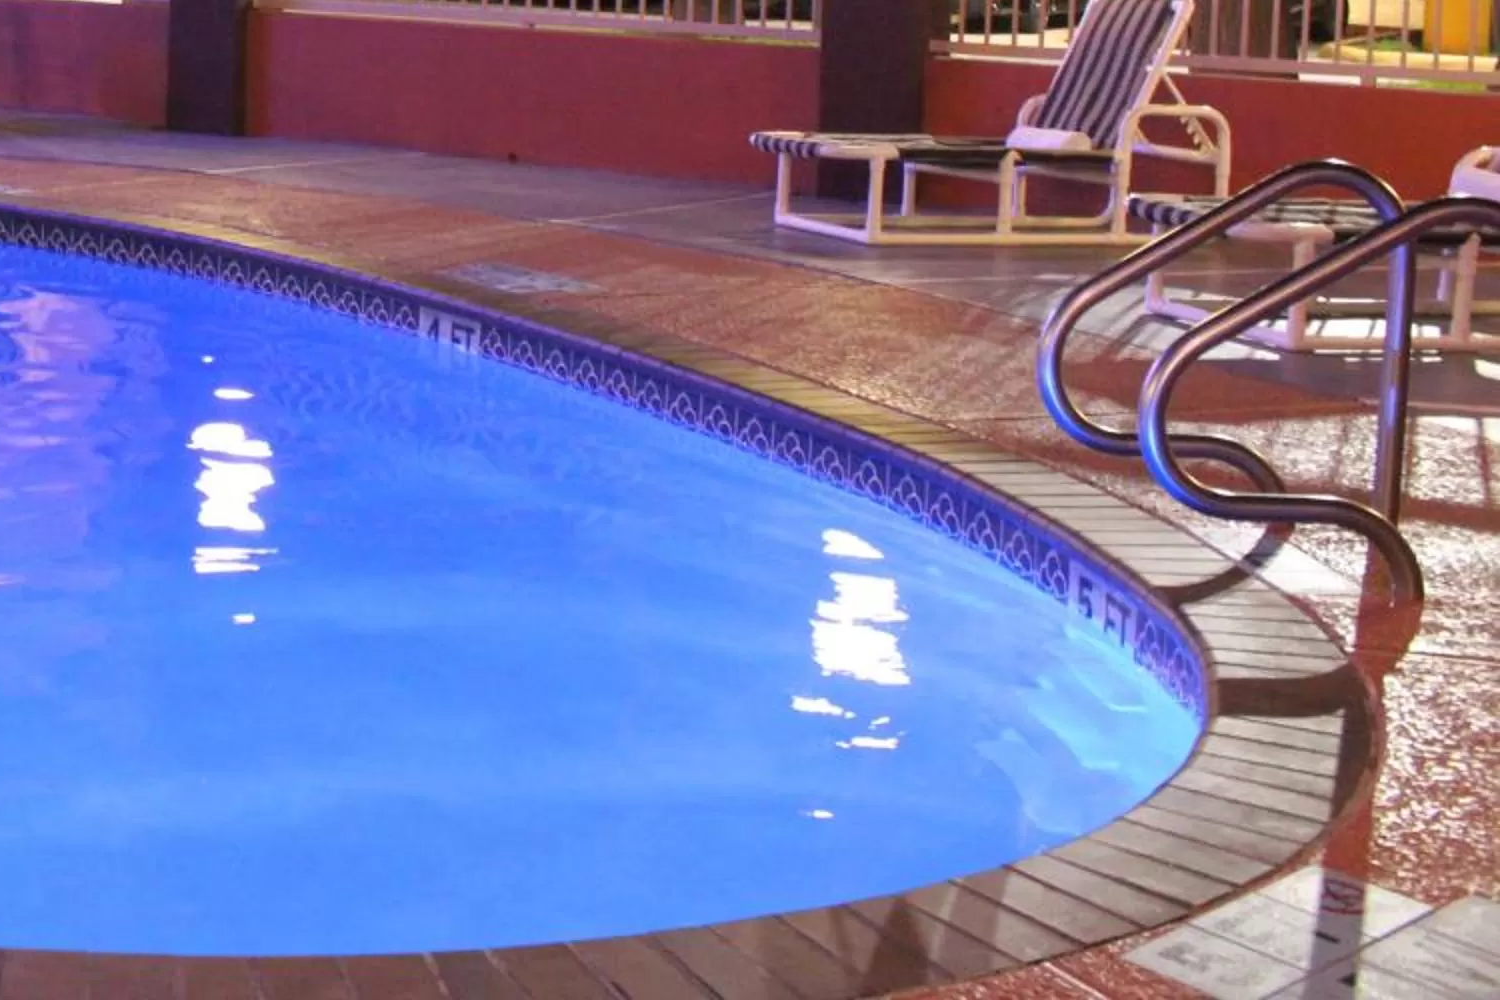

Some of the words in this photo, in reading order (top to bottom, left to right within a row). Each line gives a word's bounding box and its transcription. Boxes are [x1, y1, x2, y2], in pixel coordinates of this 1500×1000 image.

[451, 321, 475, 352] FT
[1078, 575, 1093, 620] 5
[1103, 592, 1132, 649] FT
